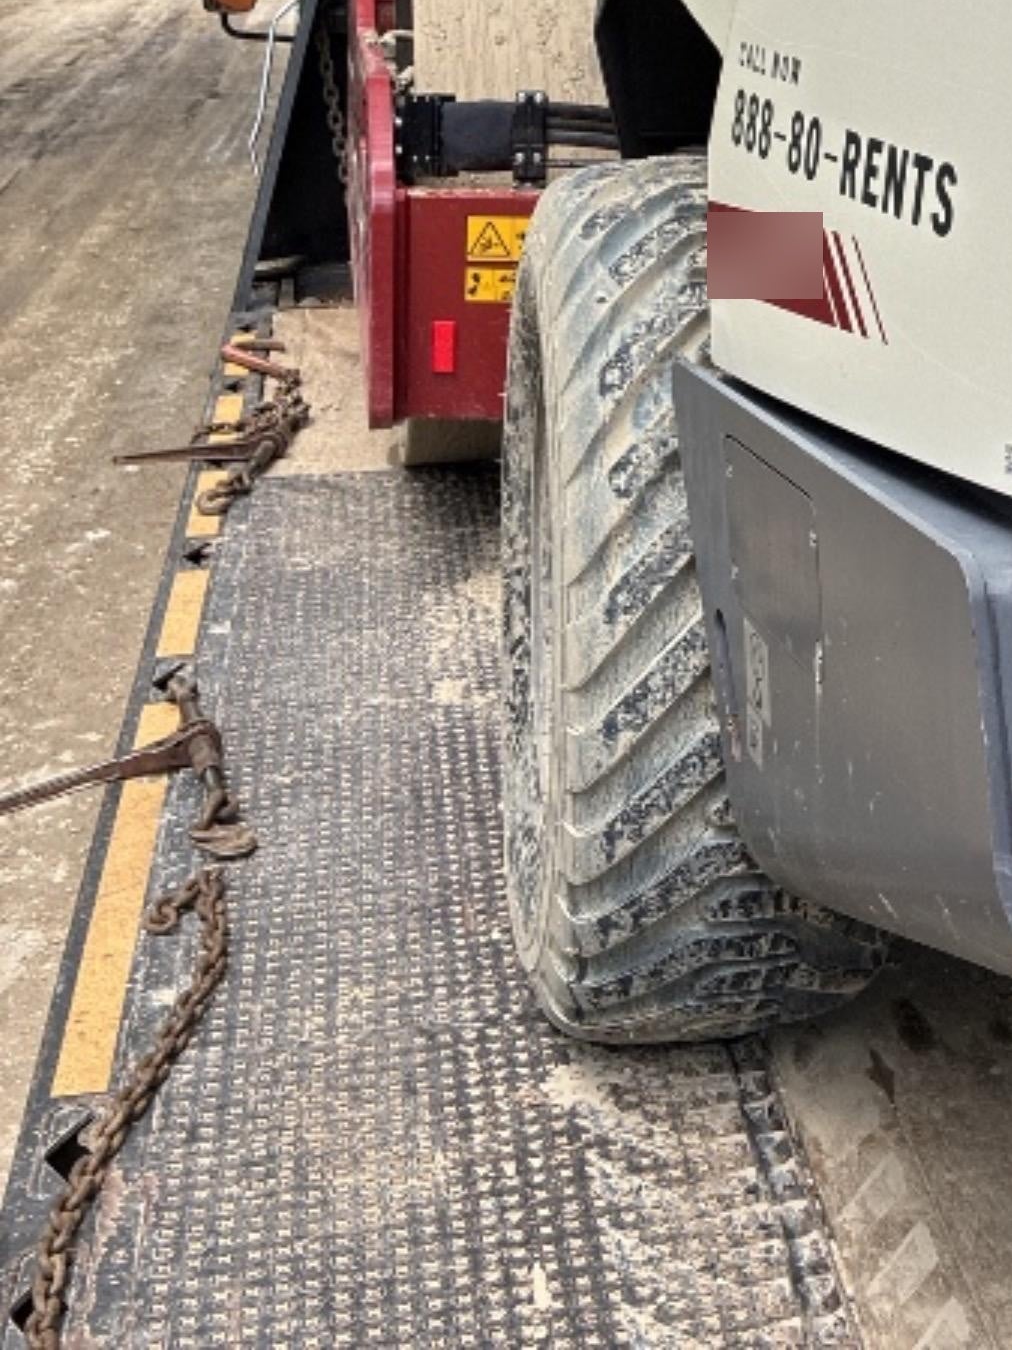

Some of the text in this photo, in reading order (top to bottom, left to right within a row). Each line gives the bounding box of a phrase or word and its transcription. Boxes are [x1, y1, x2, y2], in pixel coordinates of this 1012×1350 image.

[739, 41, 801, 84] CALL NOW
[731, 88, 958, 237] 888-80-RENTS
